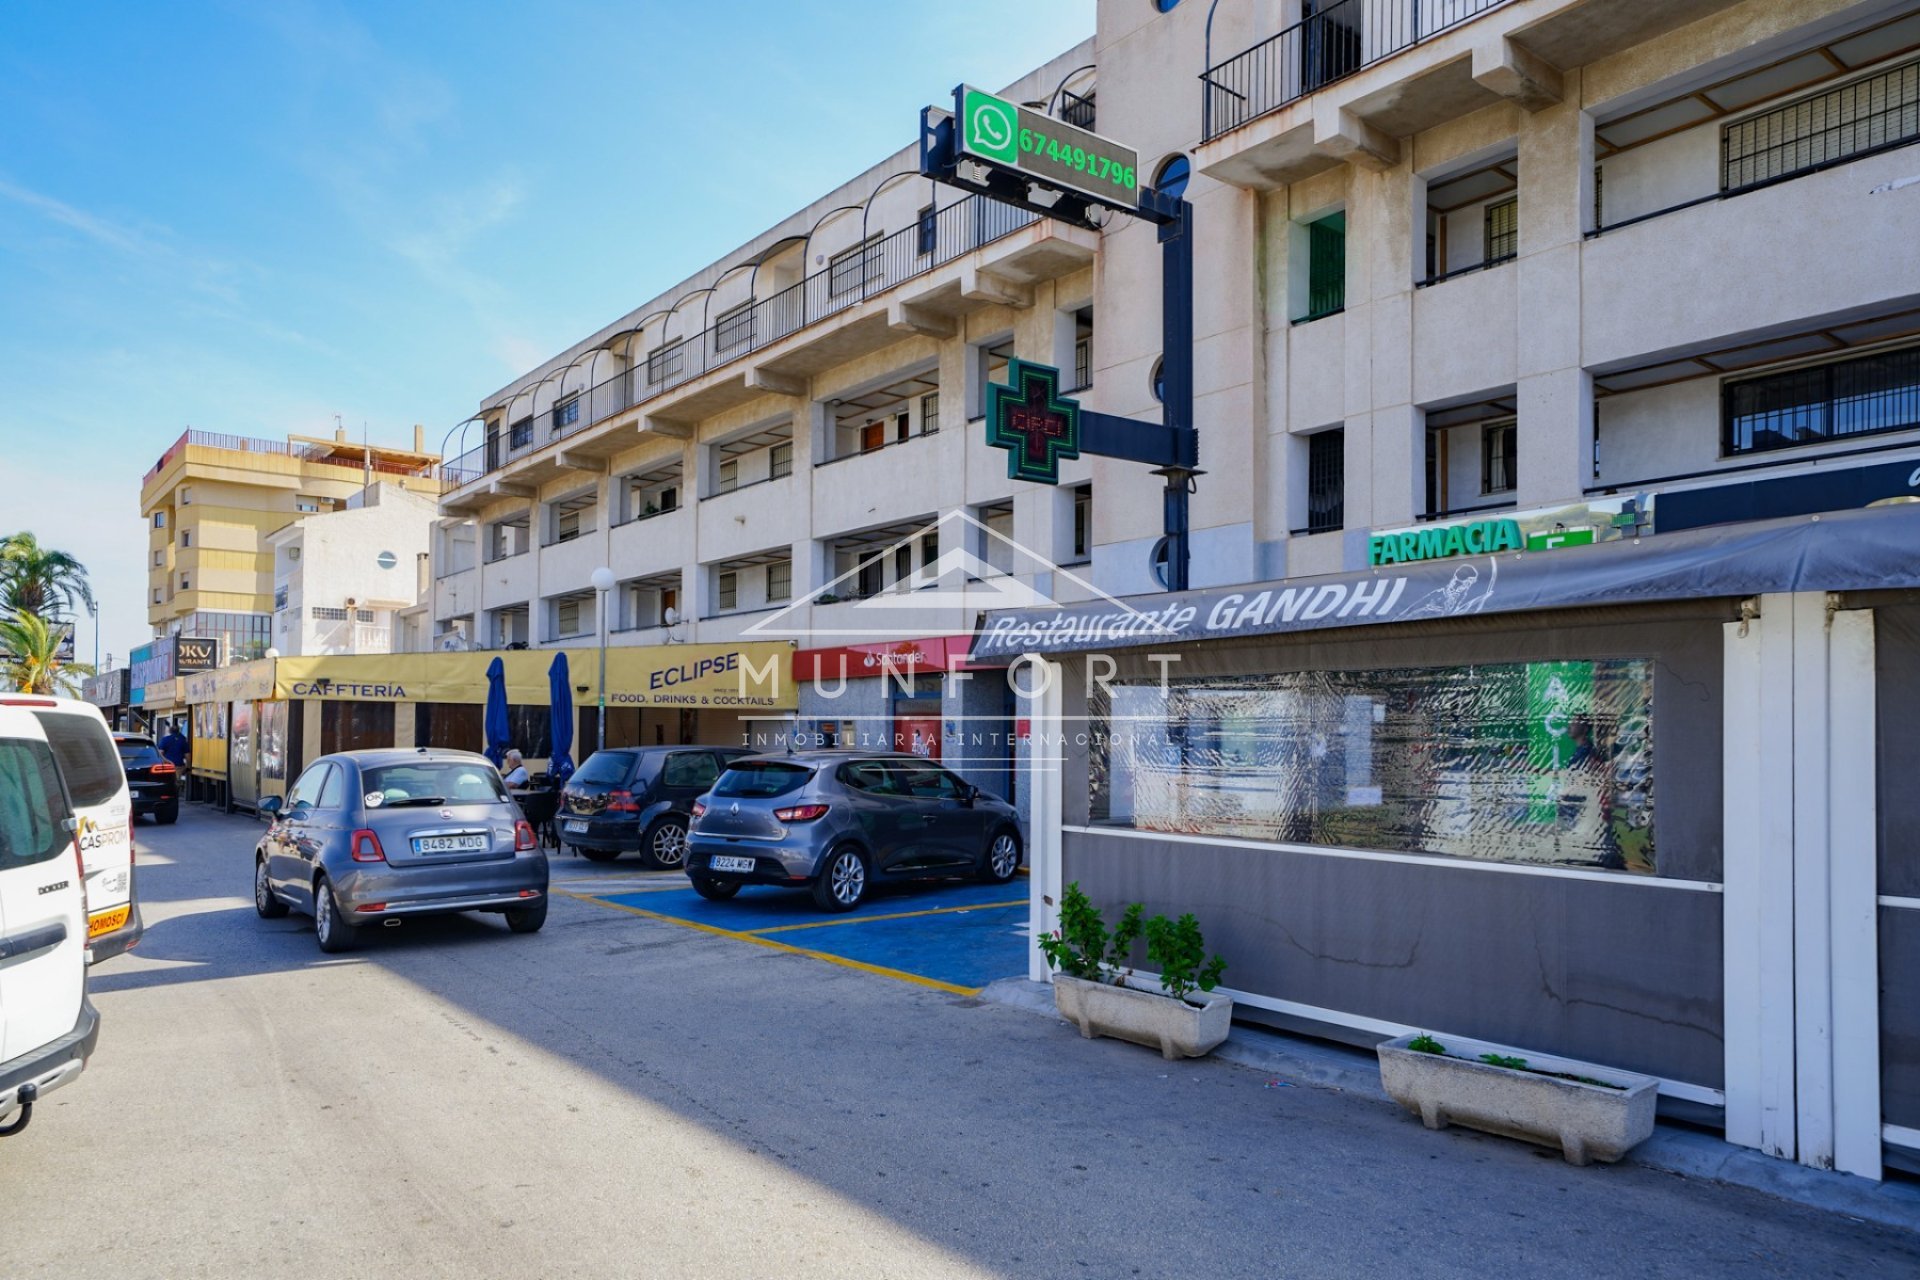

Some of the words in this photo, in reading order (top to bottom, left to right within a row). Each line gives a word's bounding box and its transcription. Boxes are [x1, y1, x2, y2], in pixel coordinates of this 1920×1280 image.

[1019, 127, 1136, 190] 674491796
[1368, 517, 1524, 567] FARMACIA
[985, 600, 1197, 650] Restaurante
[1206, 577, 1408, 630] GANDHI
[649, 652, 740, 690] ECLIPSE
[654, 694, 697, 705] DRINKS
[701, 696, 709, 705] &
[713, 696, 774, 706] COCKTAILS
[422, 838, 454, 850] 8482
[458, 836, 483, 848] MDG
[716, 857, 735, 868] 8224
